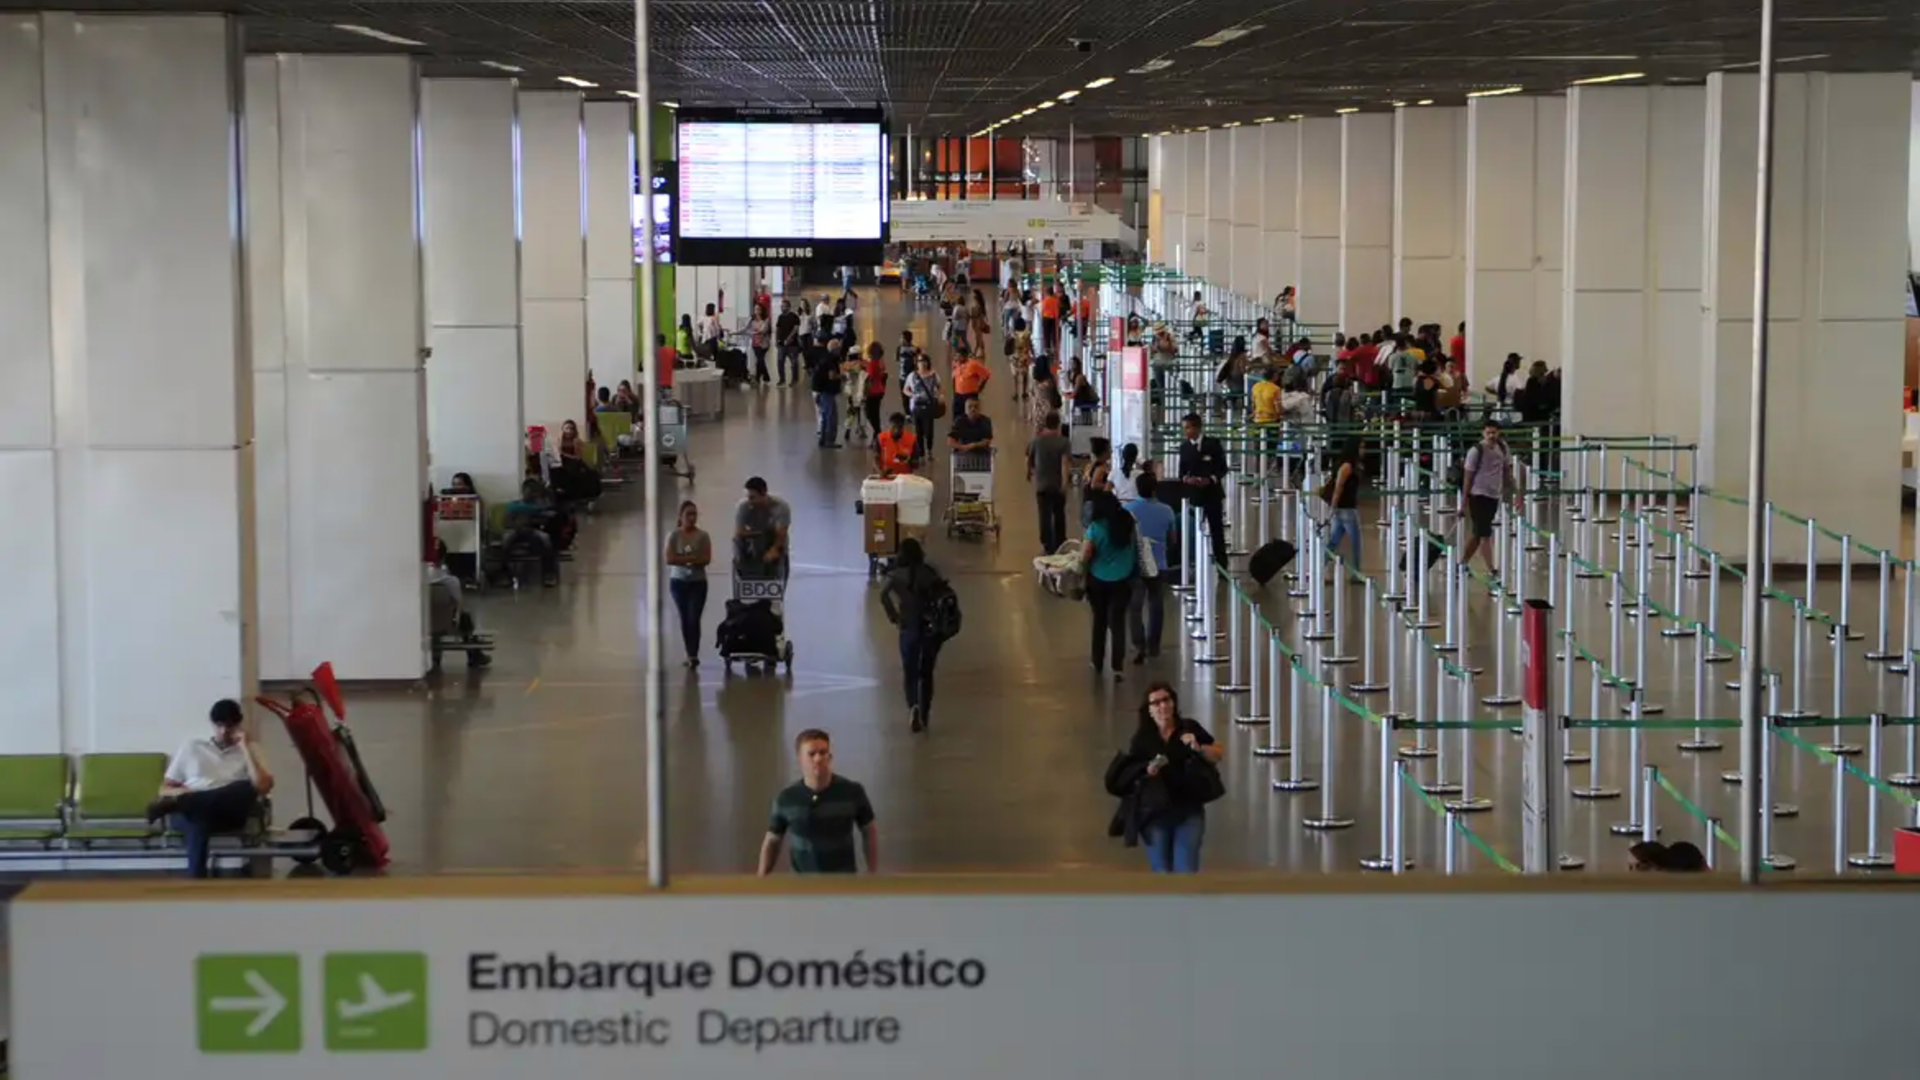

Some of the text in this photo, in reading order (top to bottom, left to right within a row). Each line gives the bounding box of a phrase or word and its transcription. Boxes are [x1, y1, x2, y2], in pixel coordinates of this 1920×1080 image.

[749, 247, 813, 258] SAMSUNG
[468, 949, 986, 997] Embarque Doméstico
[468, 1009, 901, 1052] Domestic Departure
